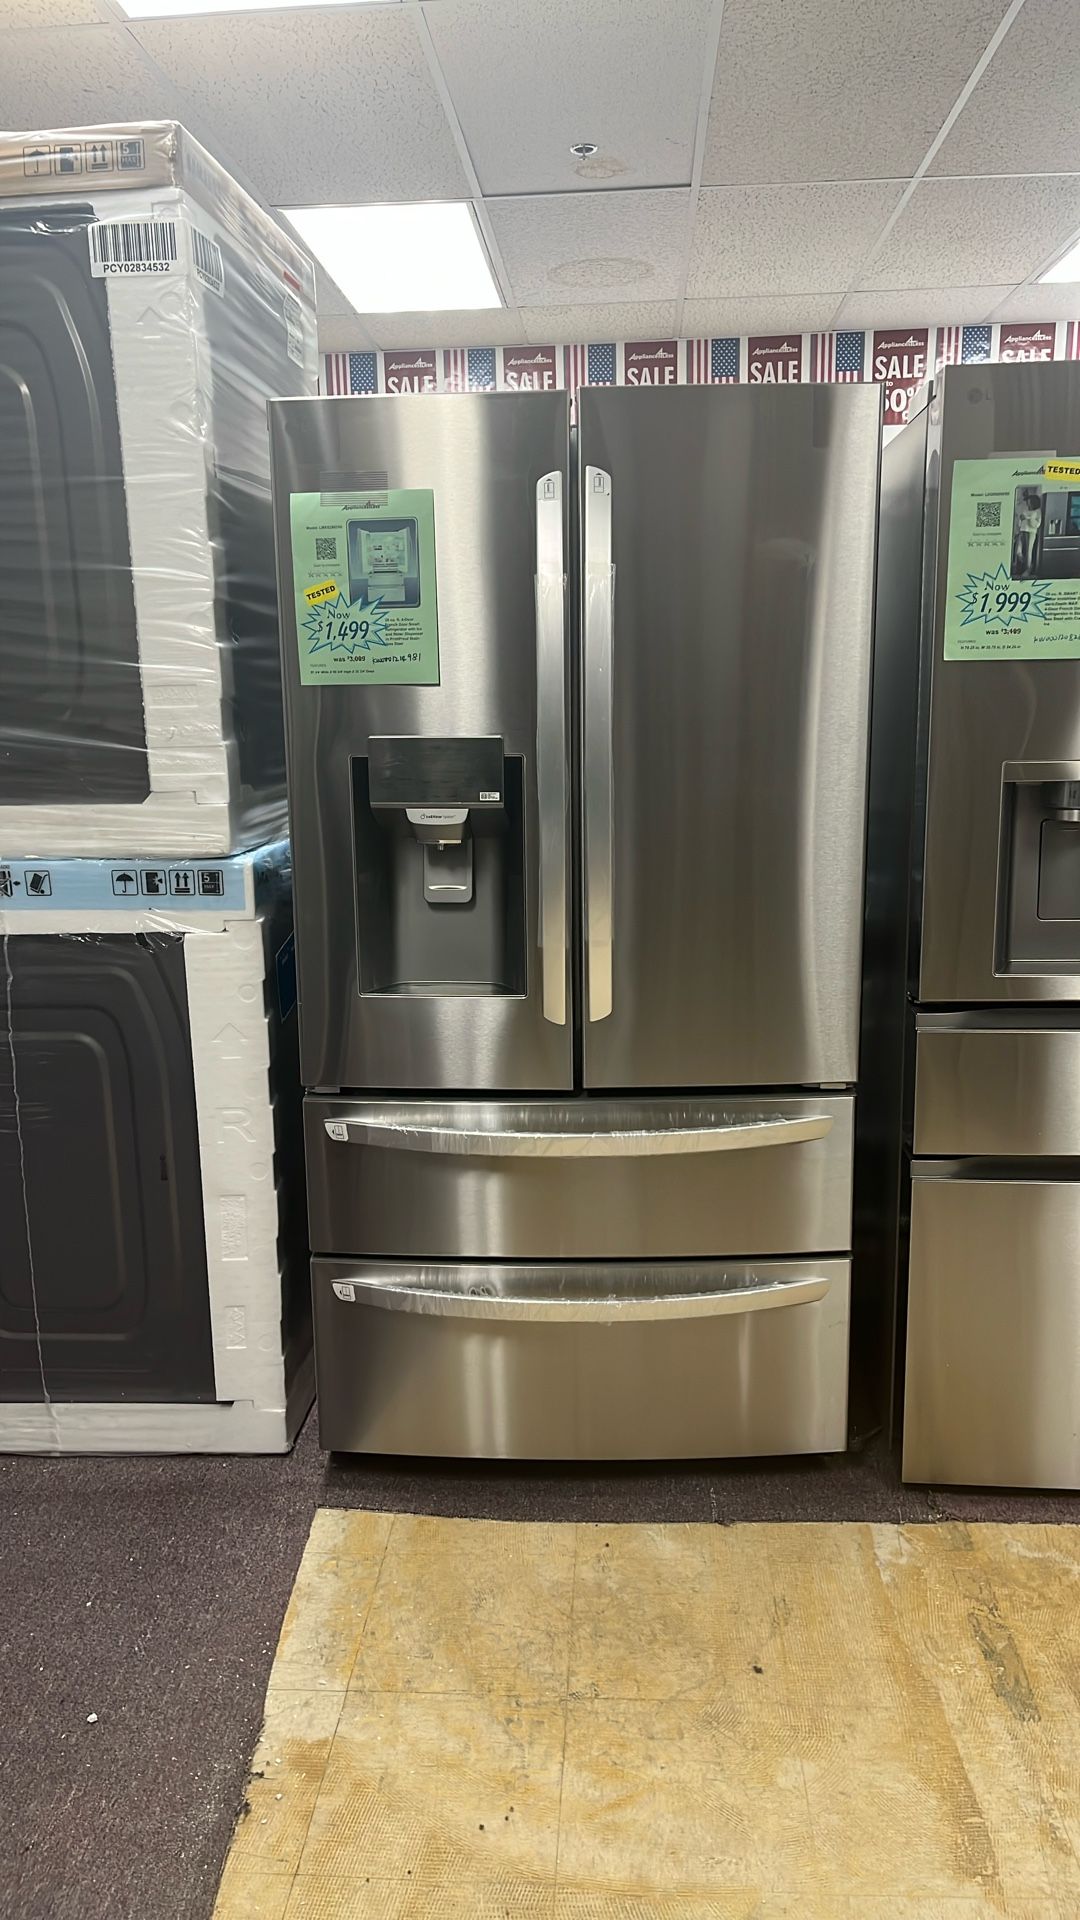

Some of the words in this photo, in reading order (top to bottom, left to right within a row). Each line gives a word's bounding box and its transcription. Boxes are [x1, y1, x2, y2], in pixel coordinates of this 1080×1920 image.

[103, 262, 170, 273] PCY02834532
[750, 360, 798, 384] SALE
[874, 354, 924, 380] SALE
[1047, 465, 1080, 475] TESTED
[306, 585, 336, 600] TESTED
[984, 580, 1010, 591] Now
[970, 591, 1032, 614] $1,999
[327, 609, 351, 620] Now
[316, 620, 370, 641] $1,499
